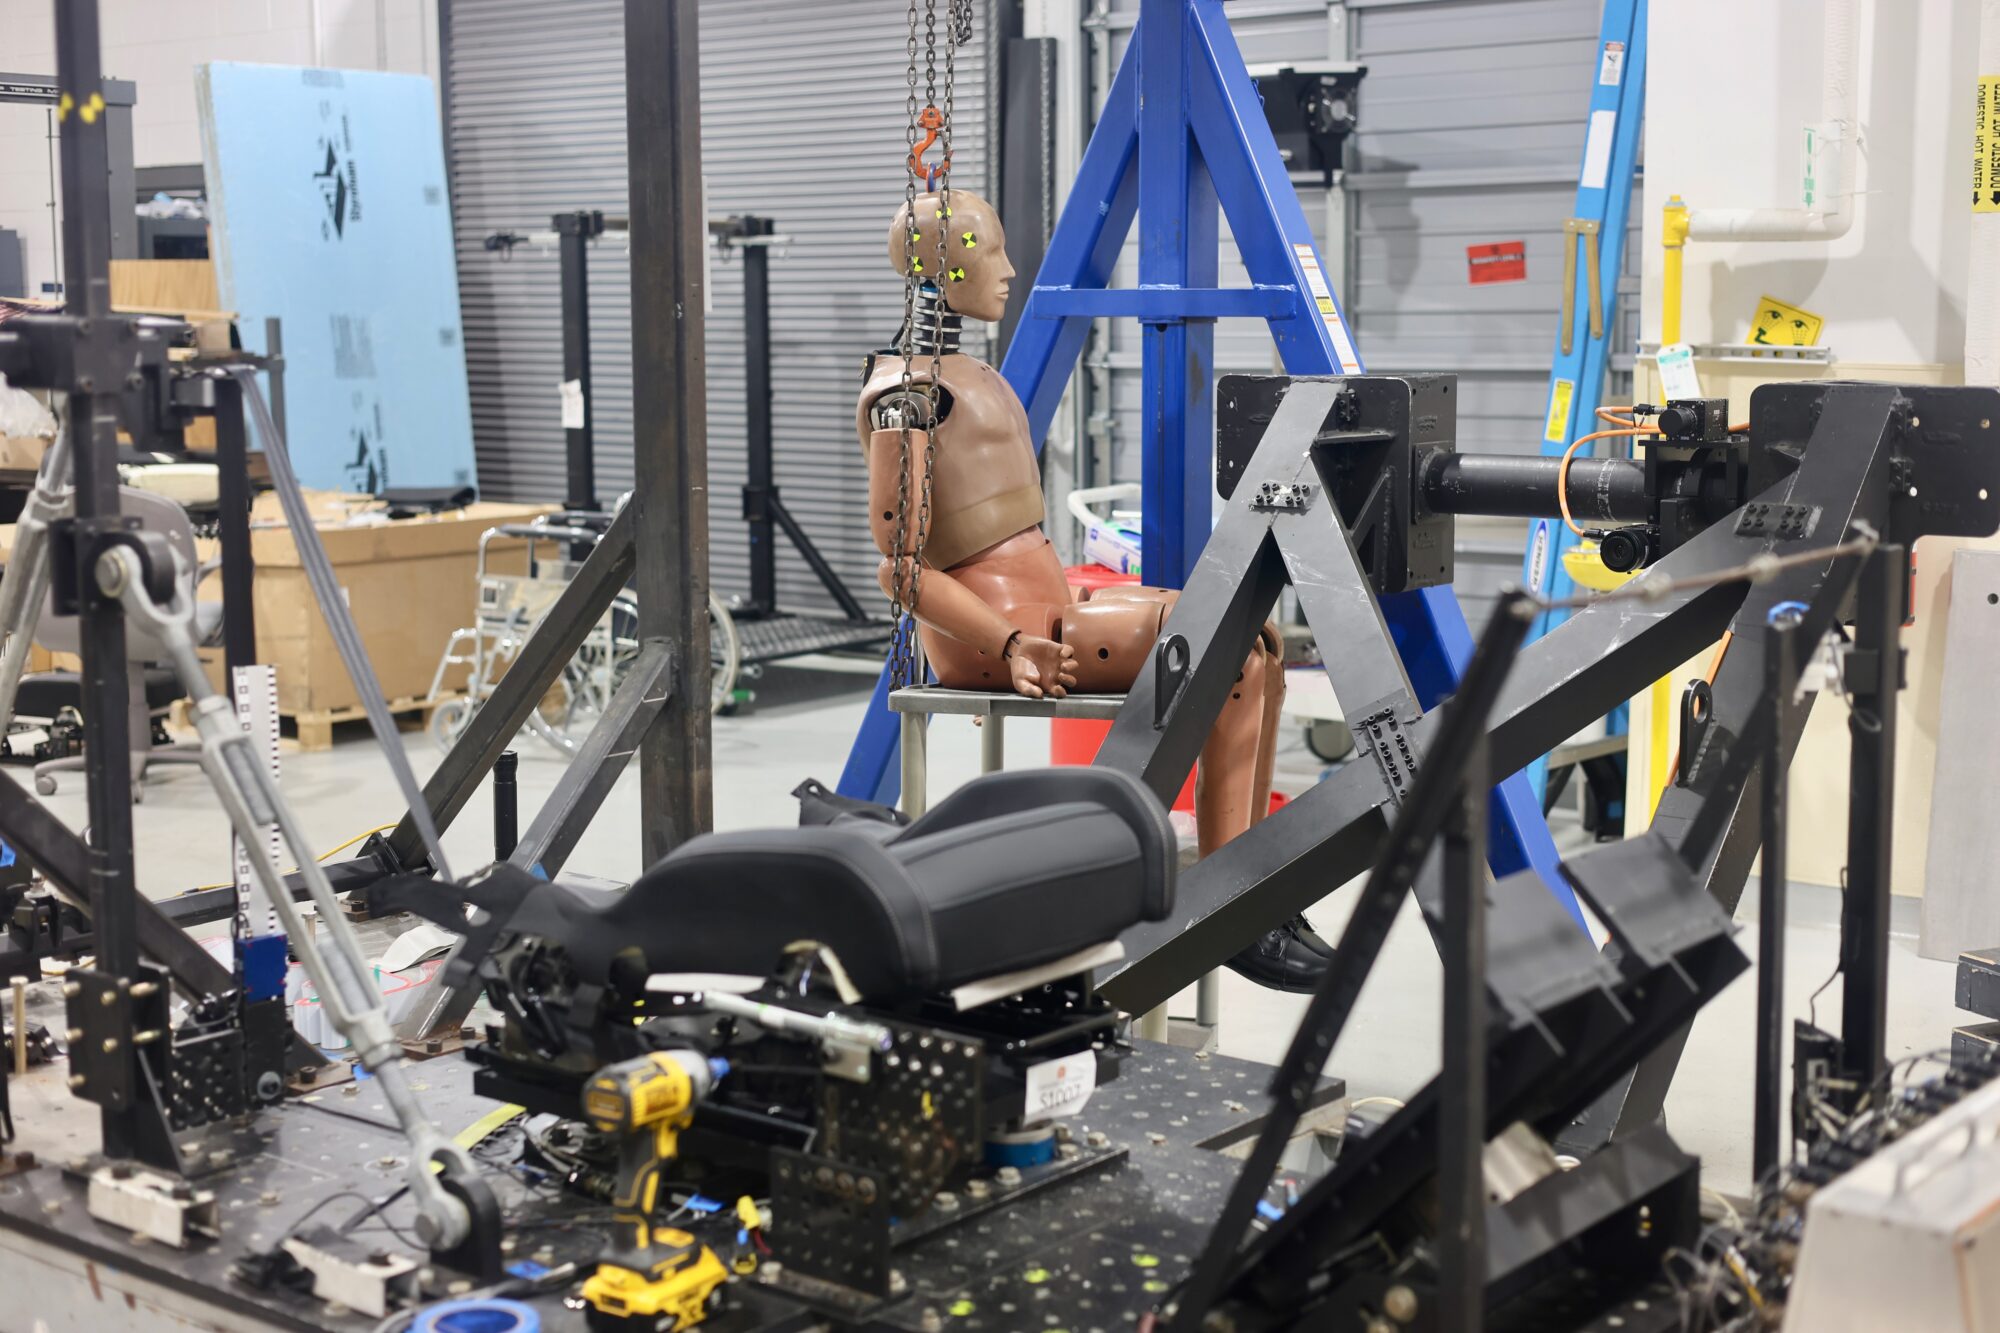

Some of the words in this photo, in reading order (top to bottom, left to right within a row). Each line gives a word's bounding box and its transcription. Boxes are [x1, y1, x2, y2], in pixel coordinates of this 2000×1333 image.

[1977, 84, 1986, 130] DOMESTIC
[1975, 135, 1984, 153] HOT
[1974, 158, 1983, 189] WATER
[1532, 535, 1543, 586] WERNER
